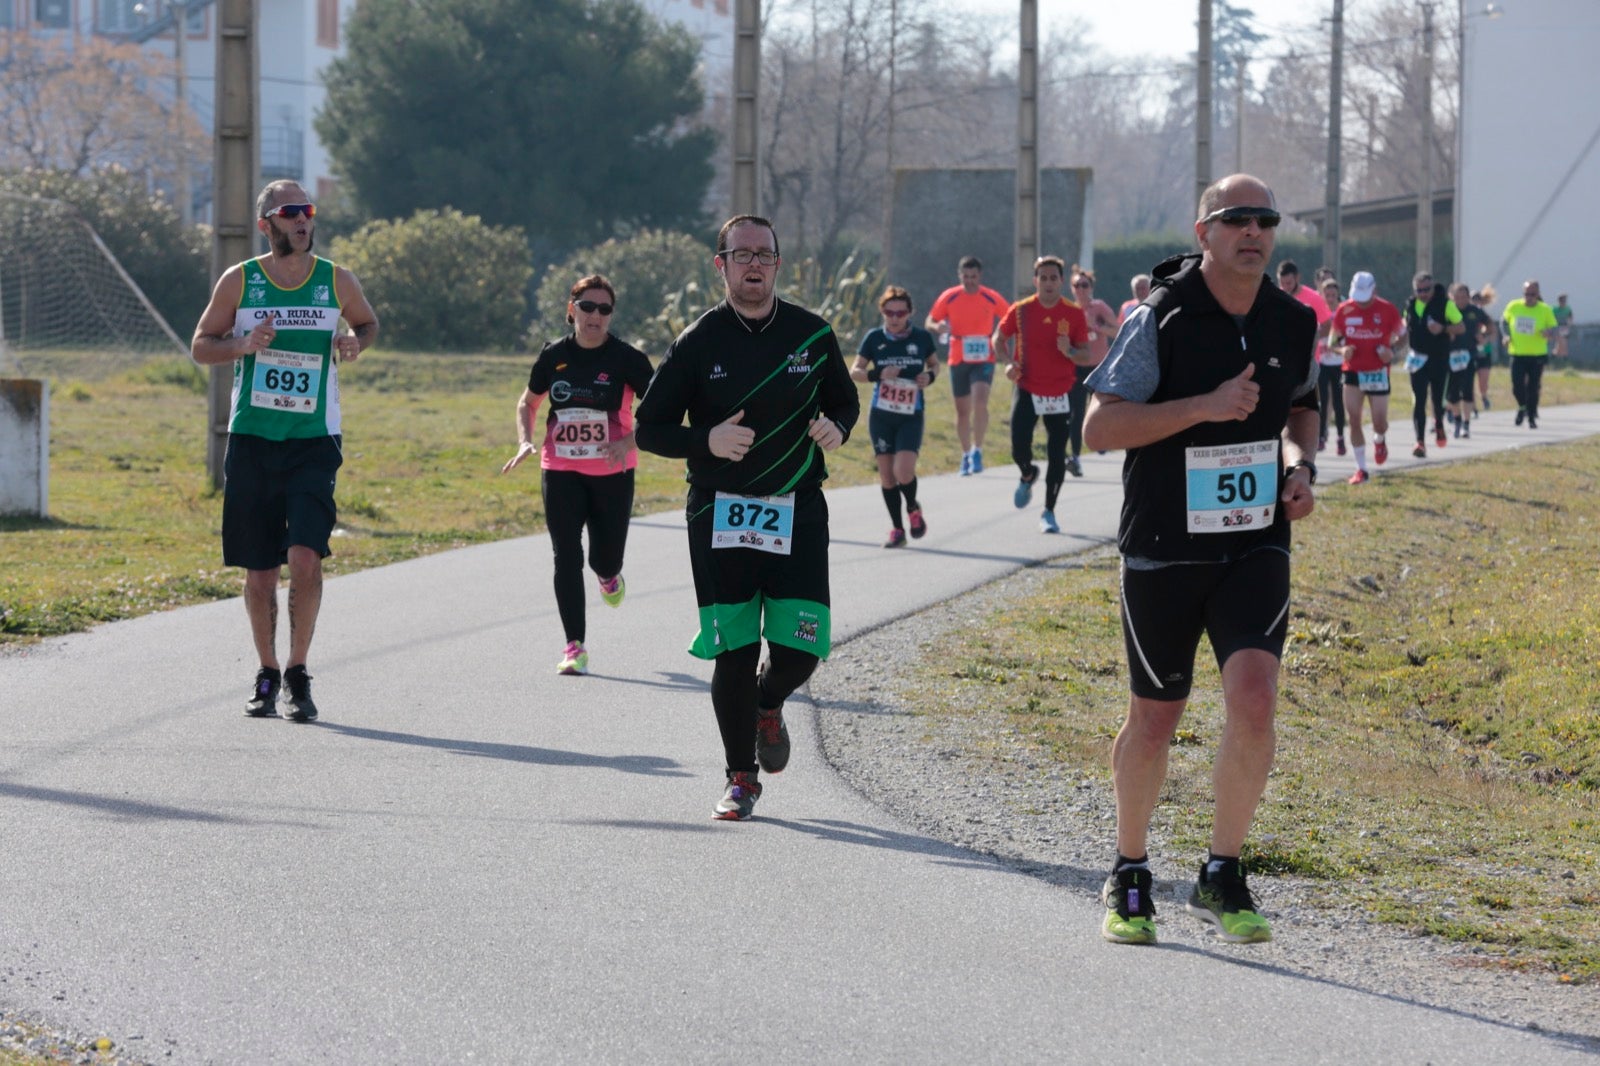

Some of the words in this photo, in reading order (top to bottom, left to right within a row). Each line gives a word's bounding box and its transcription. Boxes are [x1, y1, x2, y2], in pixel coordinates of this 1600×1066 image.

[254, 310, 282, 319] CAA
[287, 310, 326, 319] RURAL
[265, 368, 310, 393] 693
[881, 384, 914, 403] 2151
[555, 423, 605, 443] 2053
[1217, 471, 1257, 504] 50
[728, 503, 780, 532] 872
